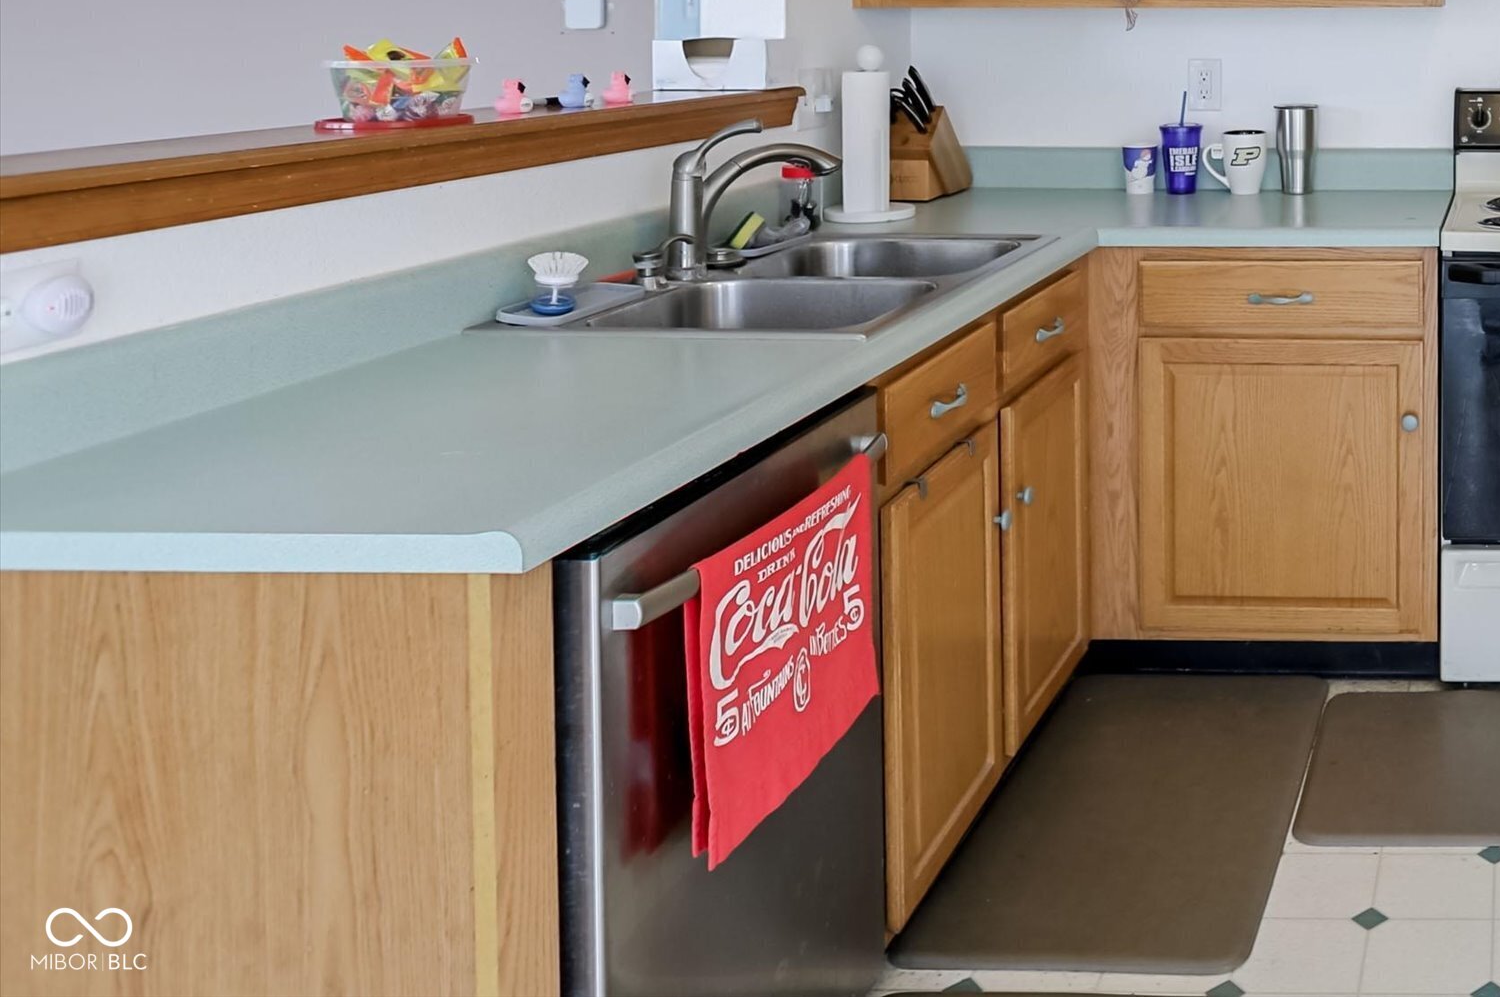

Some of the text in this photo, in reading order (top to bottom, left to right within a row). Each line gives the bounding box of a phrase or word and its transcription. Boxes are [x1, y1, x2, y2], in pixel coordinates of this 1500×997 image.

[1230, 146, 1262, 166] P
[734, 484, 851, 576] DELICIOUS AND REFRESHING
[757, 547, 796, 583] DRINK
[748, 655, 795, 723] FOUNTAINS
